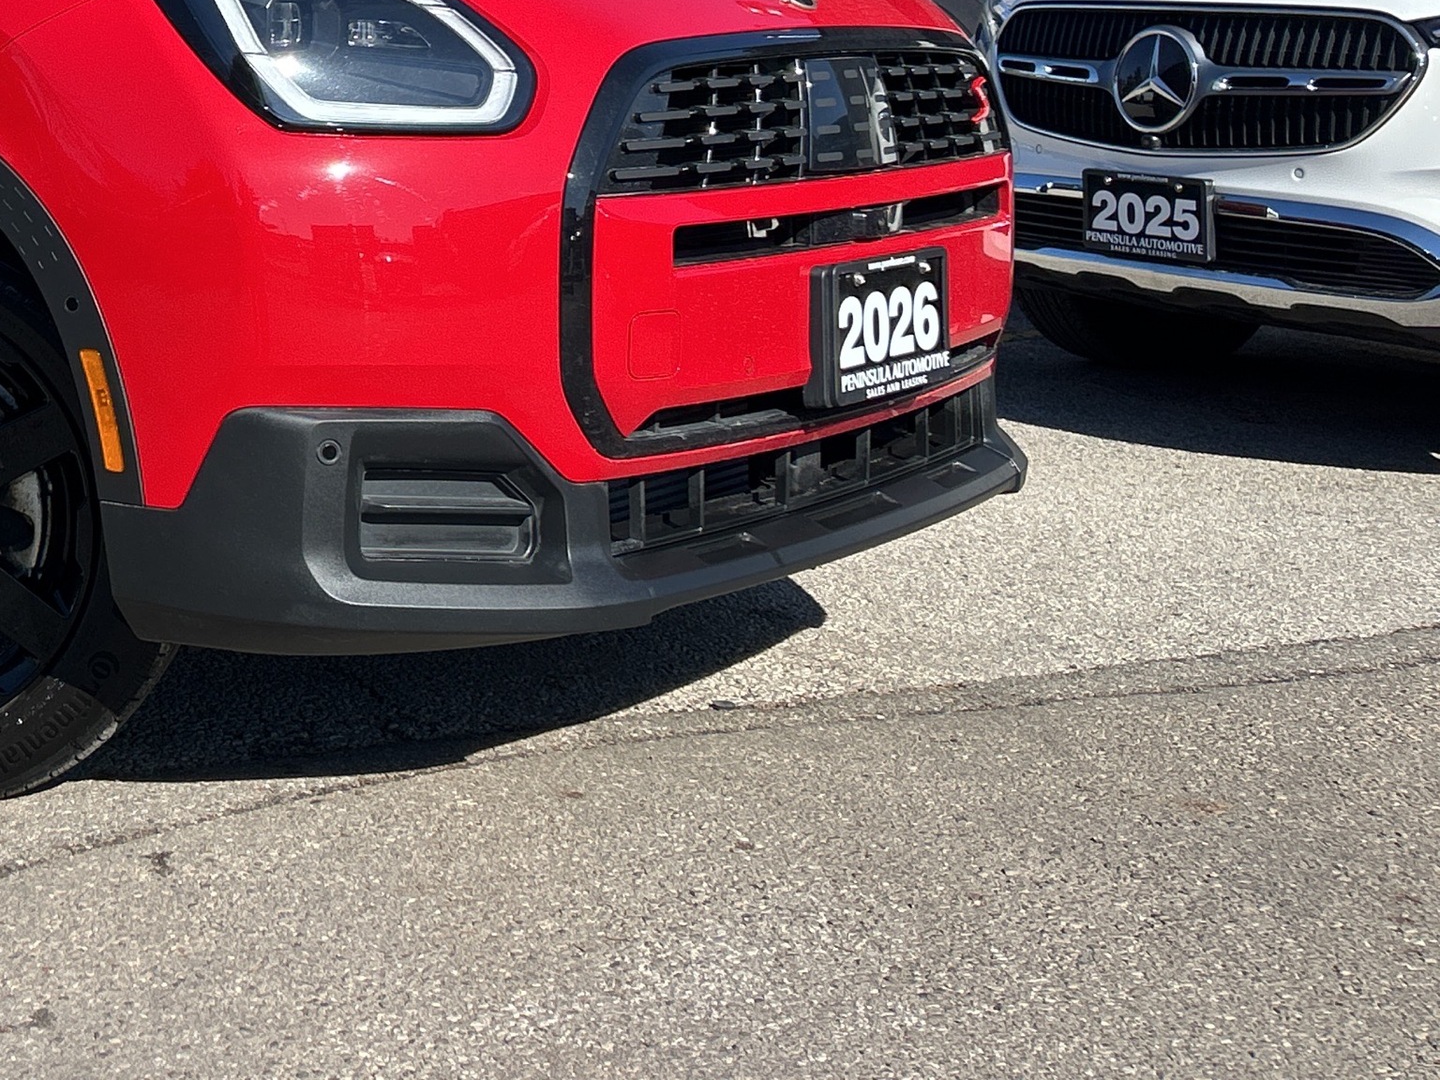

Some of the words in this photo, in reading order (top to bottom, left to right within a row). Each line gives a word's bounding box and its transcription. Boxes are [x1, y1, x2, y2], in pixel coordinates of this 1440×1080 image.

[1092, 190, 1200, 241] 2025
[1086, 230, 1137, 247] PENINSULA
[1139, 237, 1204, 255] AUTOMOTIVE
[1110, 244, 1130, 253] SALES
[1132, 246, 1146, 255] AND
[1148, 249, 1177, 259] LEASING
[838, 281, 940, 369] 2026
[841, 365, 892, 393] PENINSULA
[893, 350, 950, 379] AUTOMOTIVE
[866, 385, 886, 399] SALES
[887, 381, 901, 393] AND
[901, 375, 928, 389] LEASING
